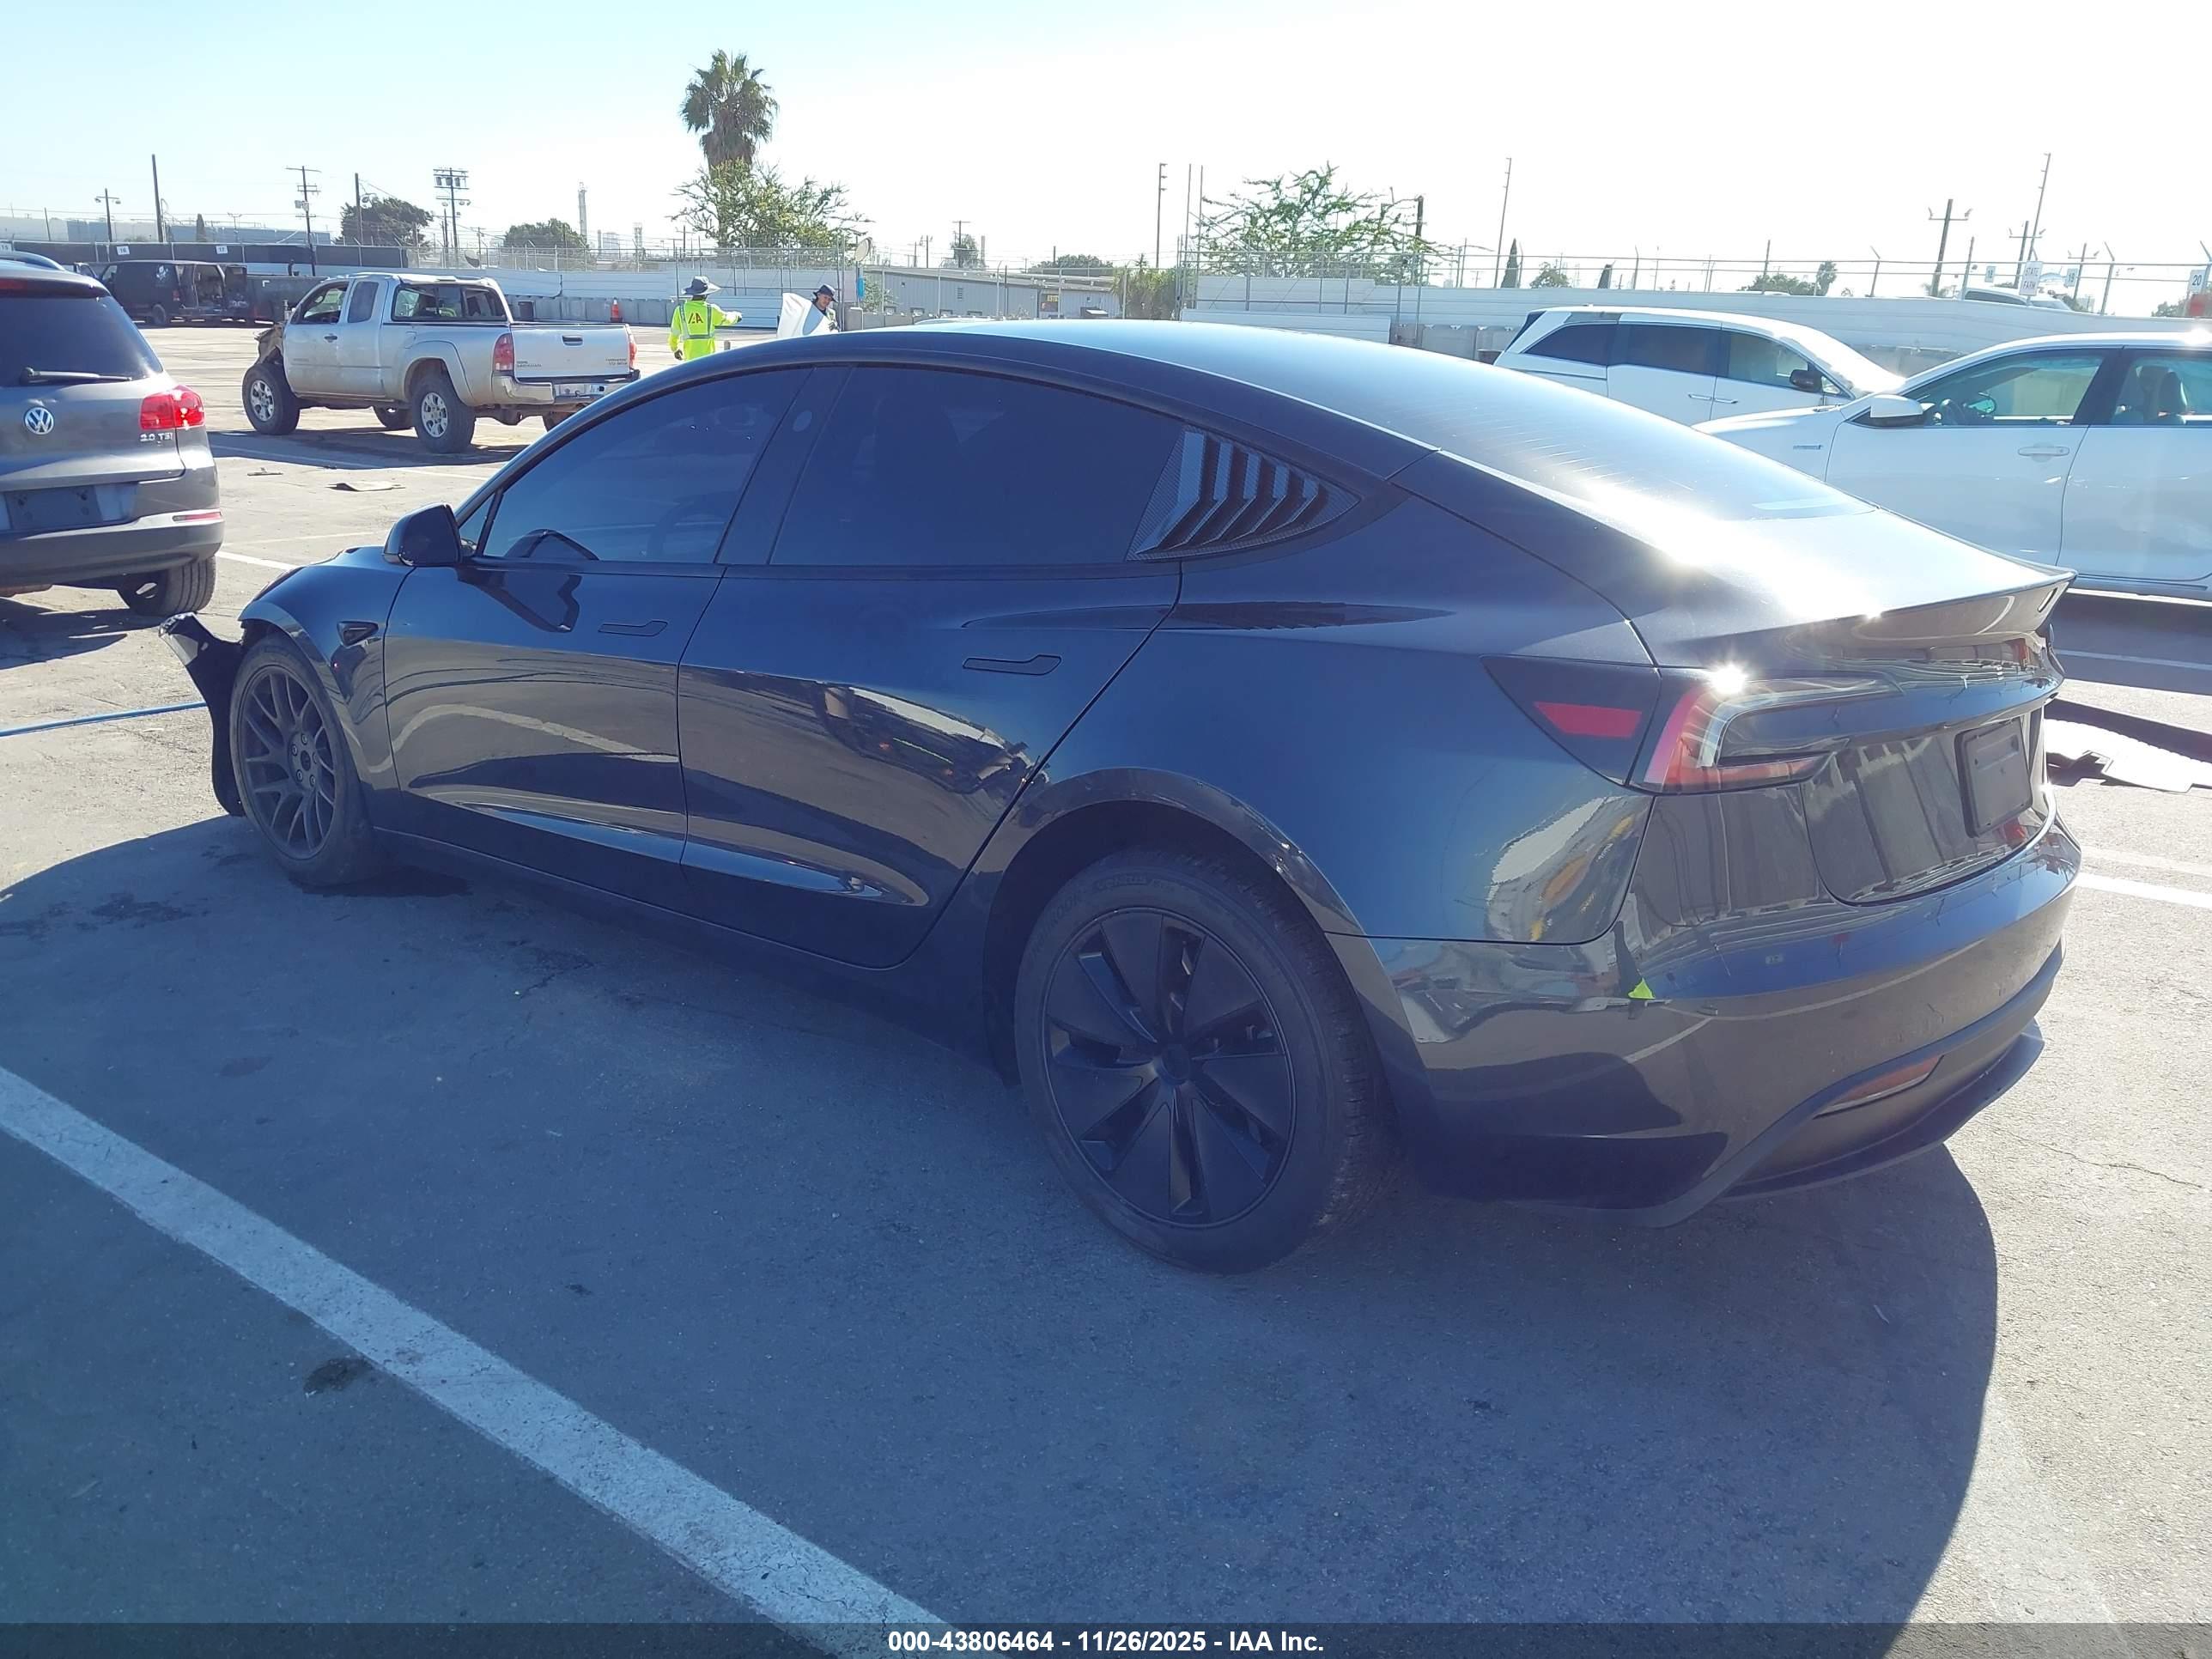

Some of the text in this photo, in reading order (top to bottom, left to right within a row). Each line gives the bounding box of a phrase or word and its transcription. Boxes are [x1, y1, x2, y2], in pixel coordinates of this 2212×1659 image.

[2026, 267, 2040, 276] STATE
[2022, 280, 2037, 289] FARM
[2191, 274, 2203, 286] 20
